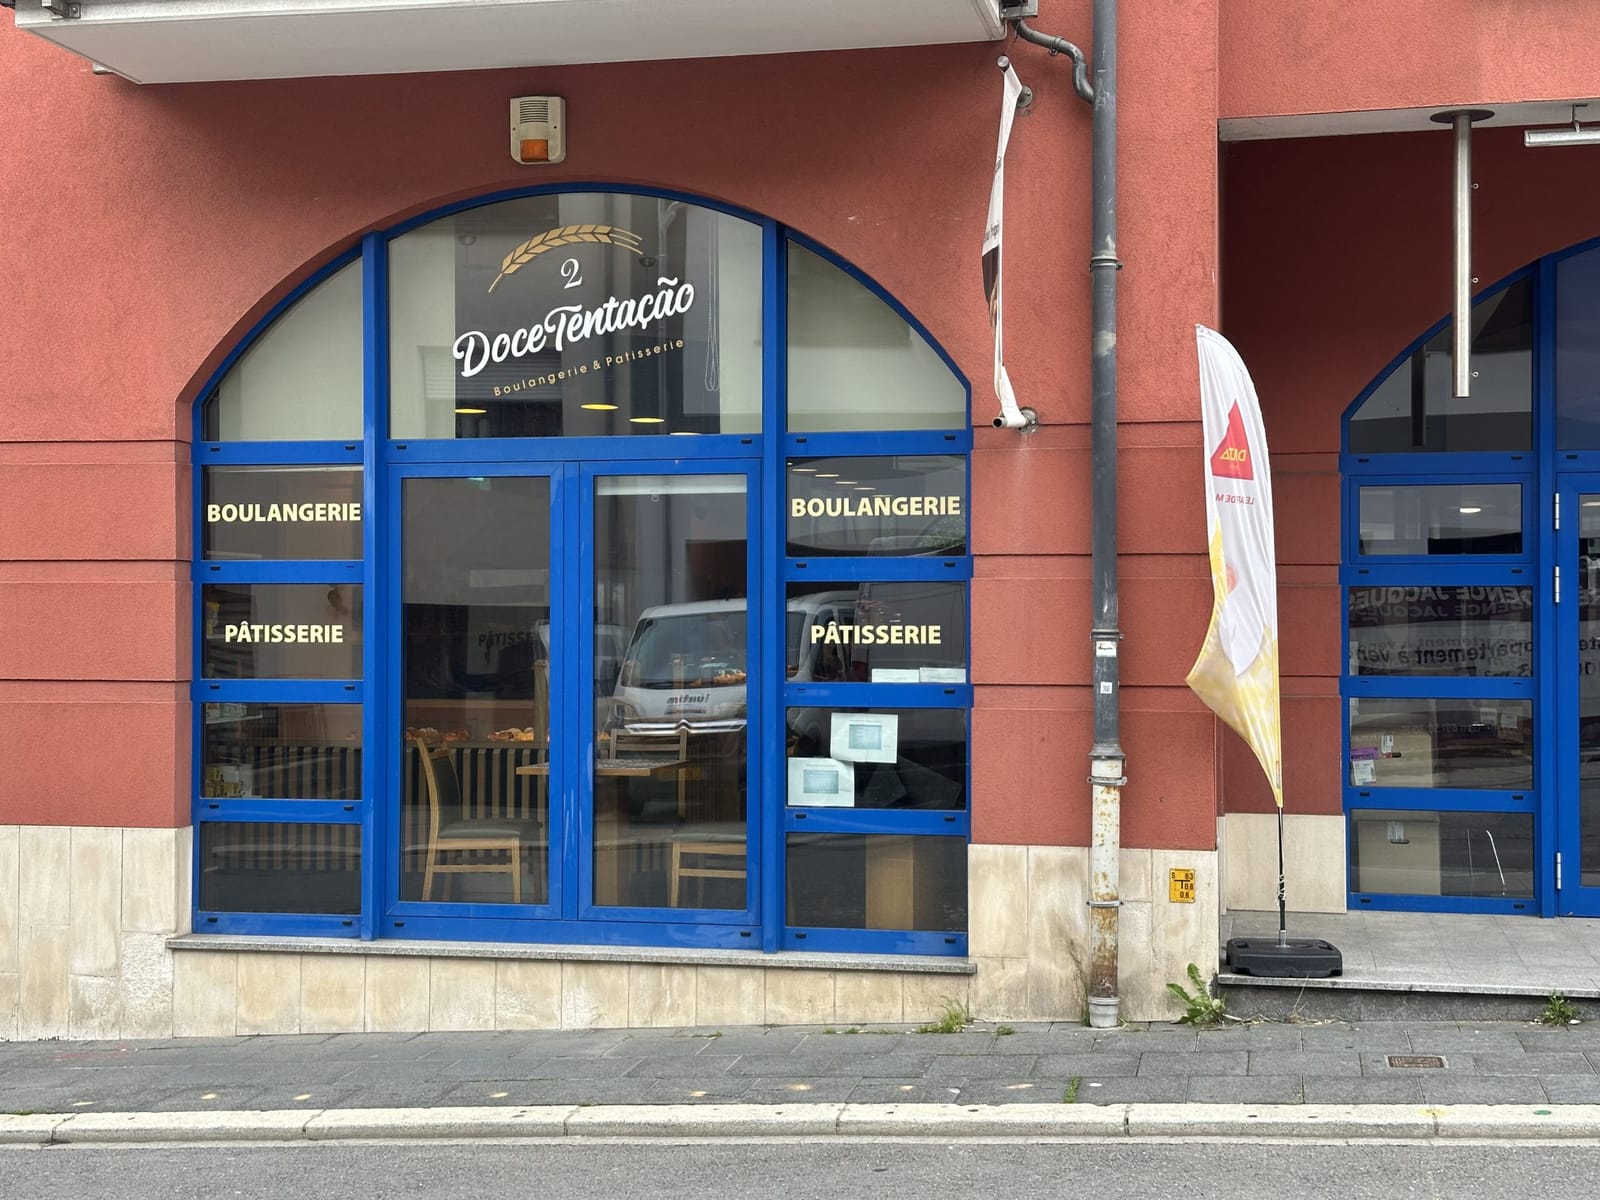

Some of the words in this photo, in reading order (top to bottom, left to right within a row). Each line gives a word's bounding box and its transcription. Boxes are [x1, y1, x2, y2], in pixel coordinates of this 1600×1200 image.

[560, 258, 583, 289] 2
[452, 322, 547, 378] Doce
[544, 276, 695, 352] Tentação
[493, 364, 587, 397] Boulangerie
[592, 359, 601, 370] &
[605, 338, 685, 367] Patisserie
[207, 503, 361, 523] BOULANGERIE
[791, 496, 961, 517] BOULANGERIE
[225, 620, 344, 643] PÂTISSERIE
[810, 621, 942, 645] PÂTISSERIE
